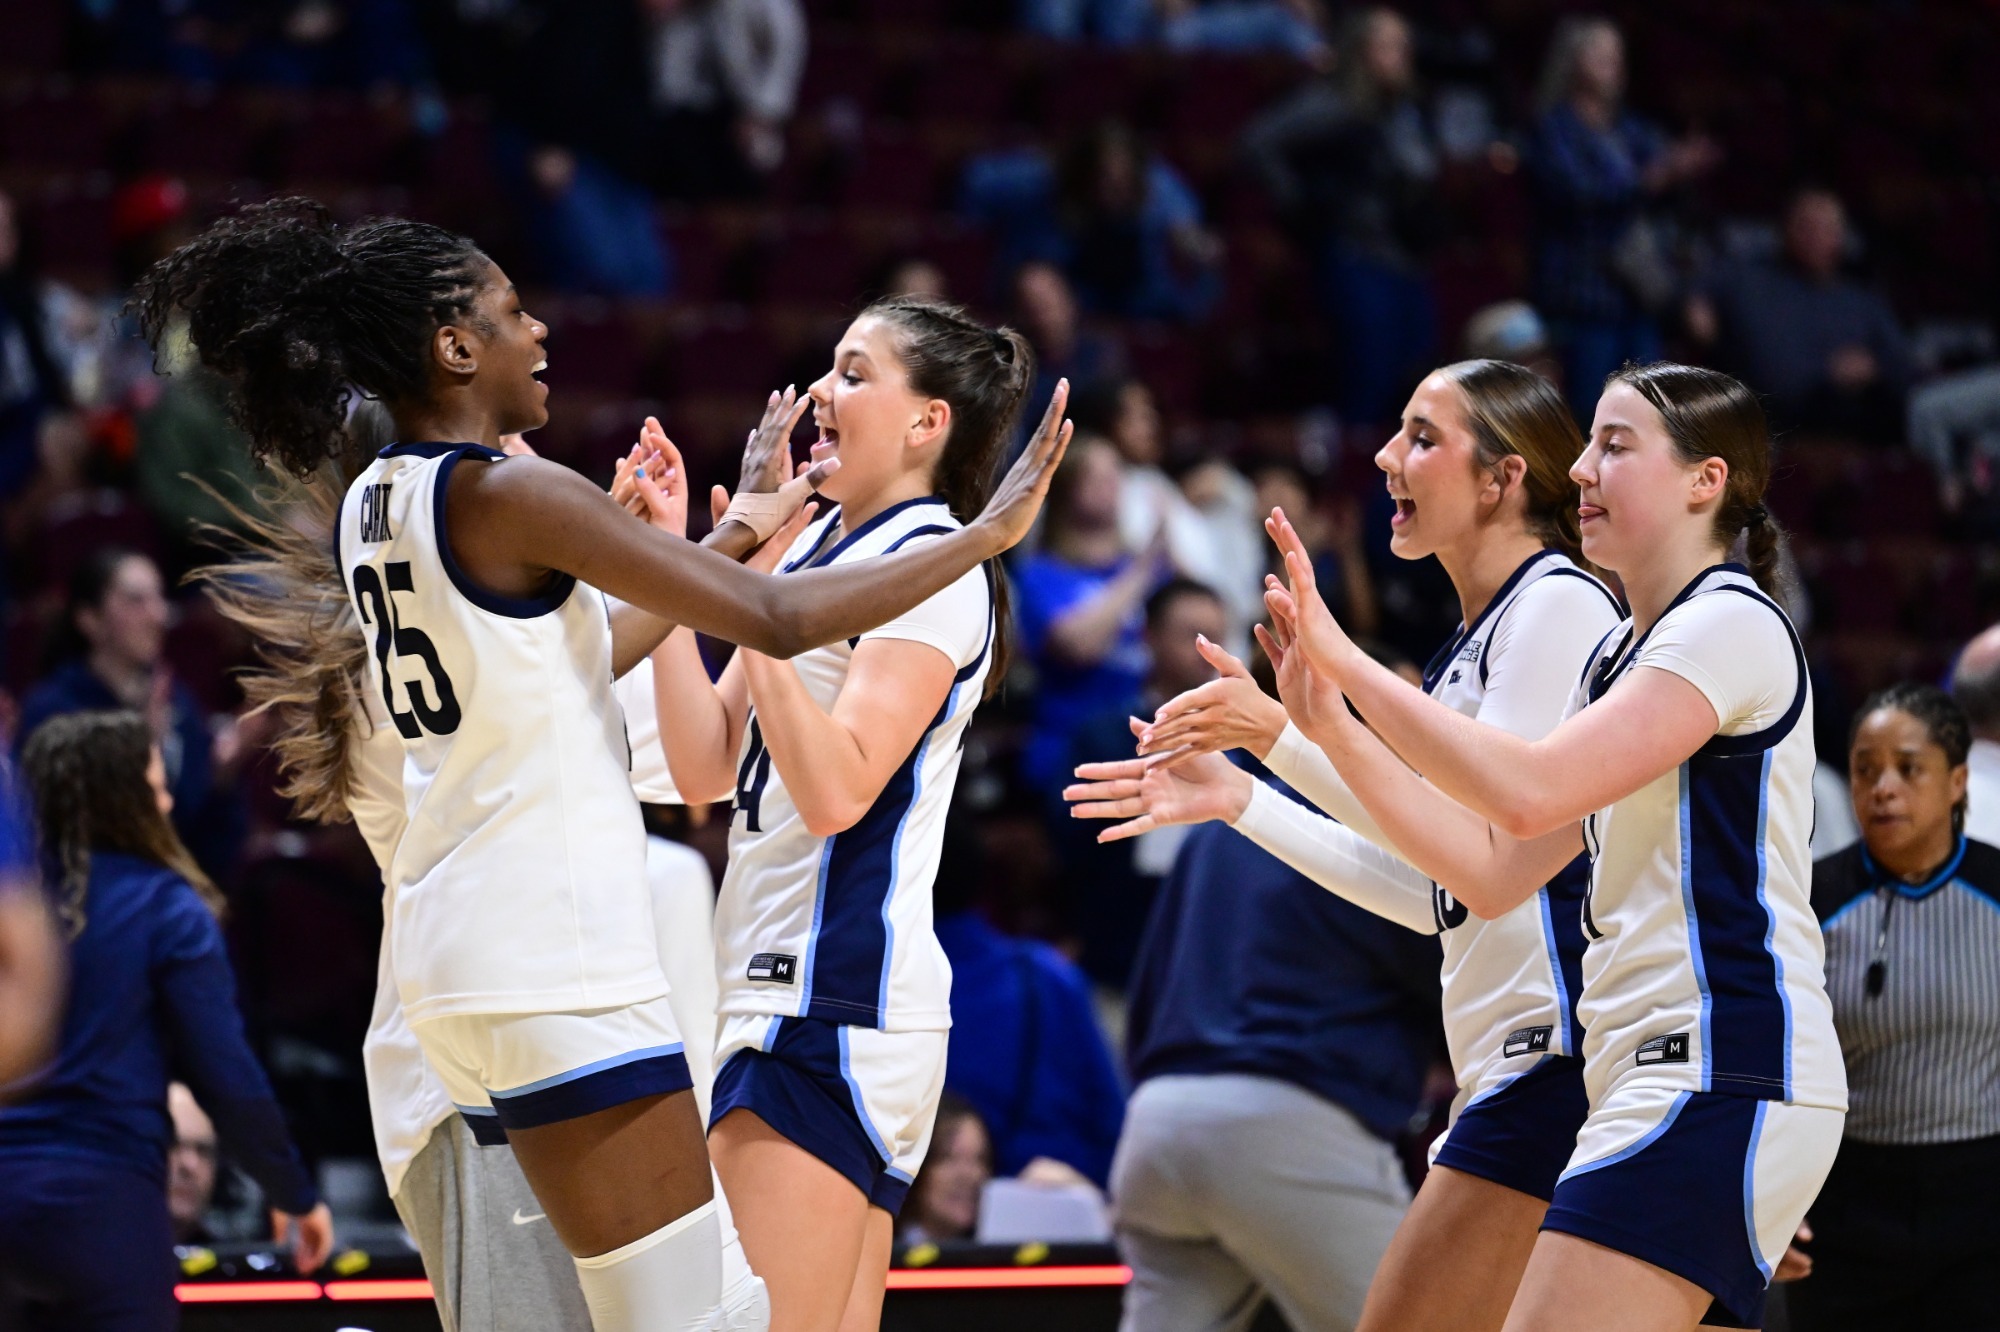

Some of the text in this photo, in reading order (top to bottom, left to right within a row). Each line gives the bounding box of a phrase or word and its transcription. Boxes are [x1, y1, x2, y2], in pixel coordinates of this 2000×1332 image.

[353, 561, 462, 739] 25
[729, 705, 772, 832] 4
[777, 962, 789, 975] M
[1533, 1033, 1544, 1045] M
[1670, 1041, 1681, 1053] M
